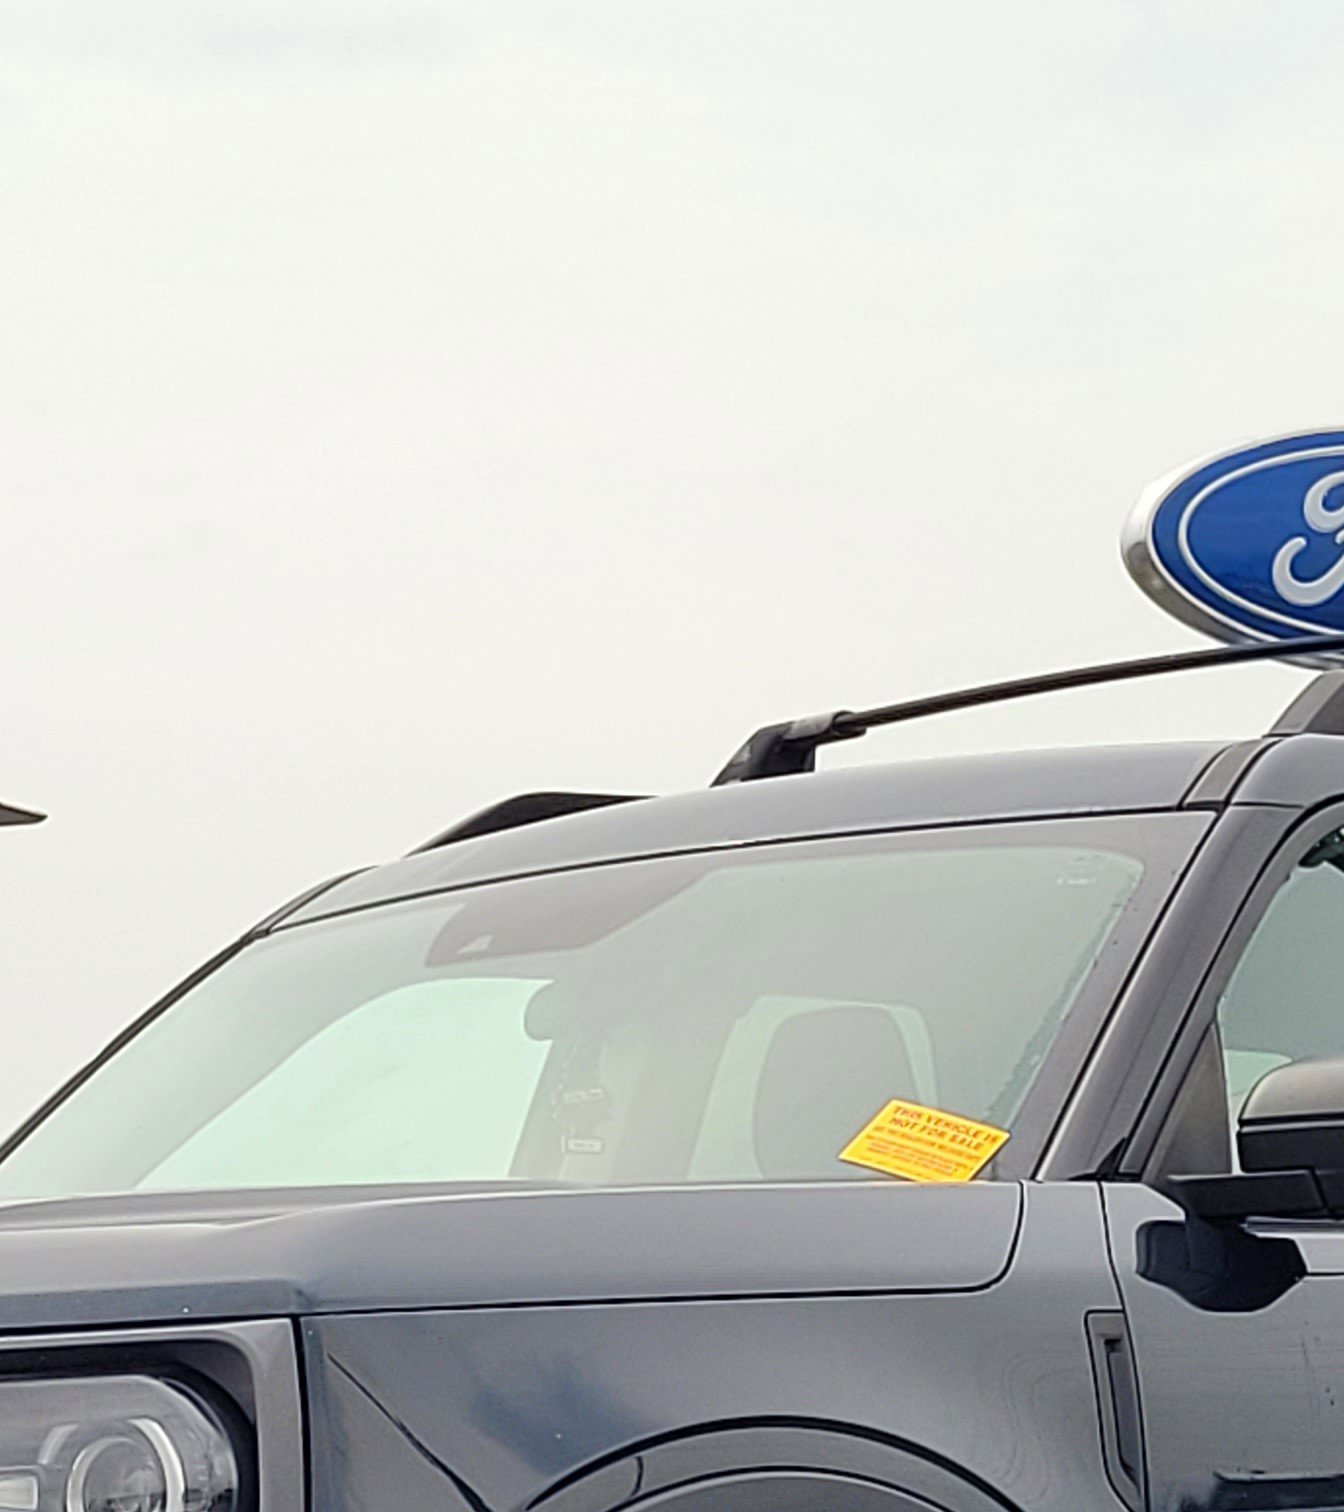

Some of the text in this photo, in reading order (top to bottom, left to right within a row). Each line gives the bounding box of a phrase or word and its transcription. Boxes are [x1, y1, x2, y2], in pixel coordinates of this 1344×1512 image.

[889, 1117, 983, 1151] NOT FOR SALE
